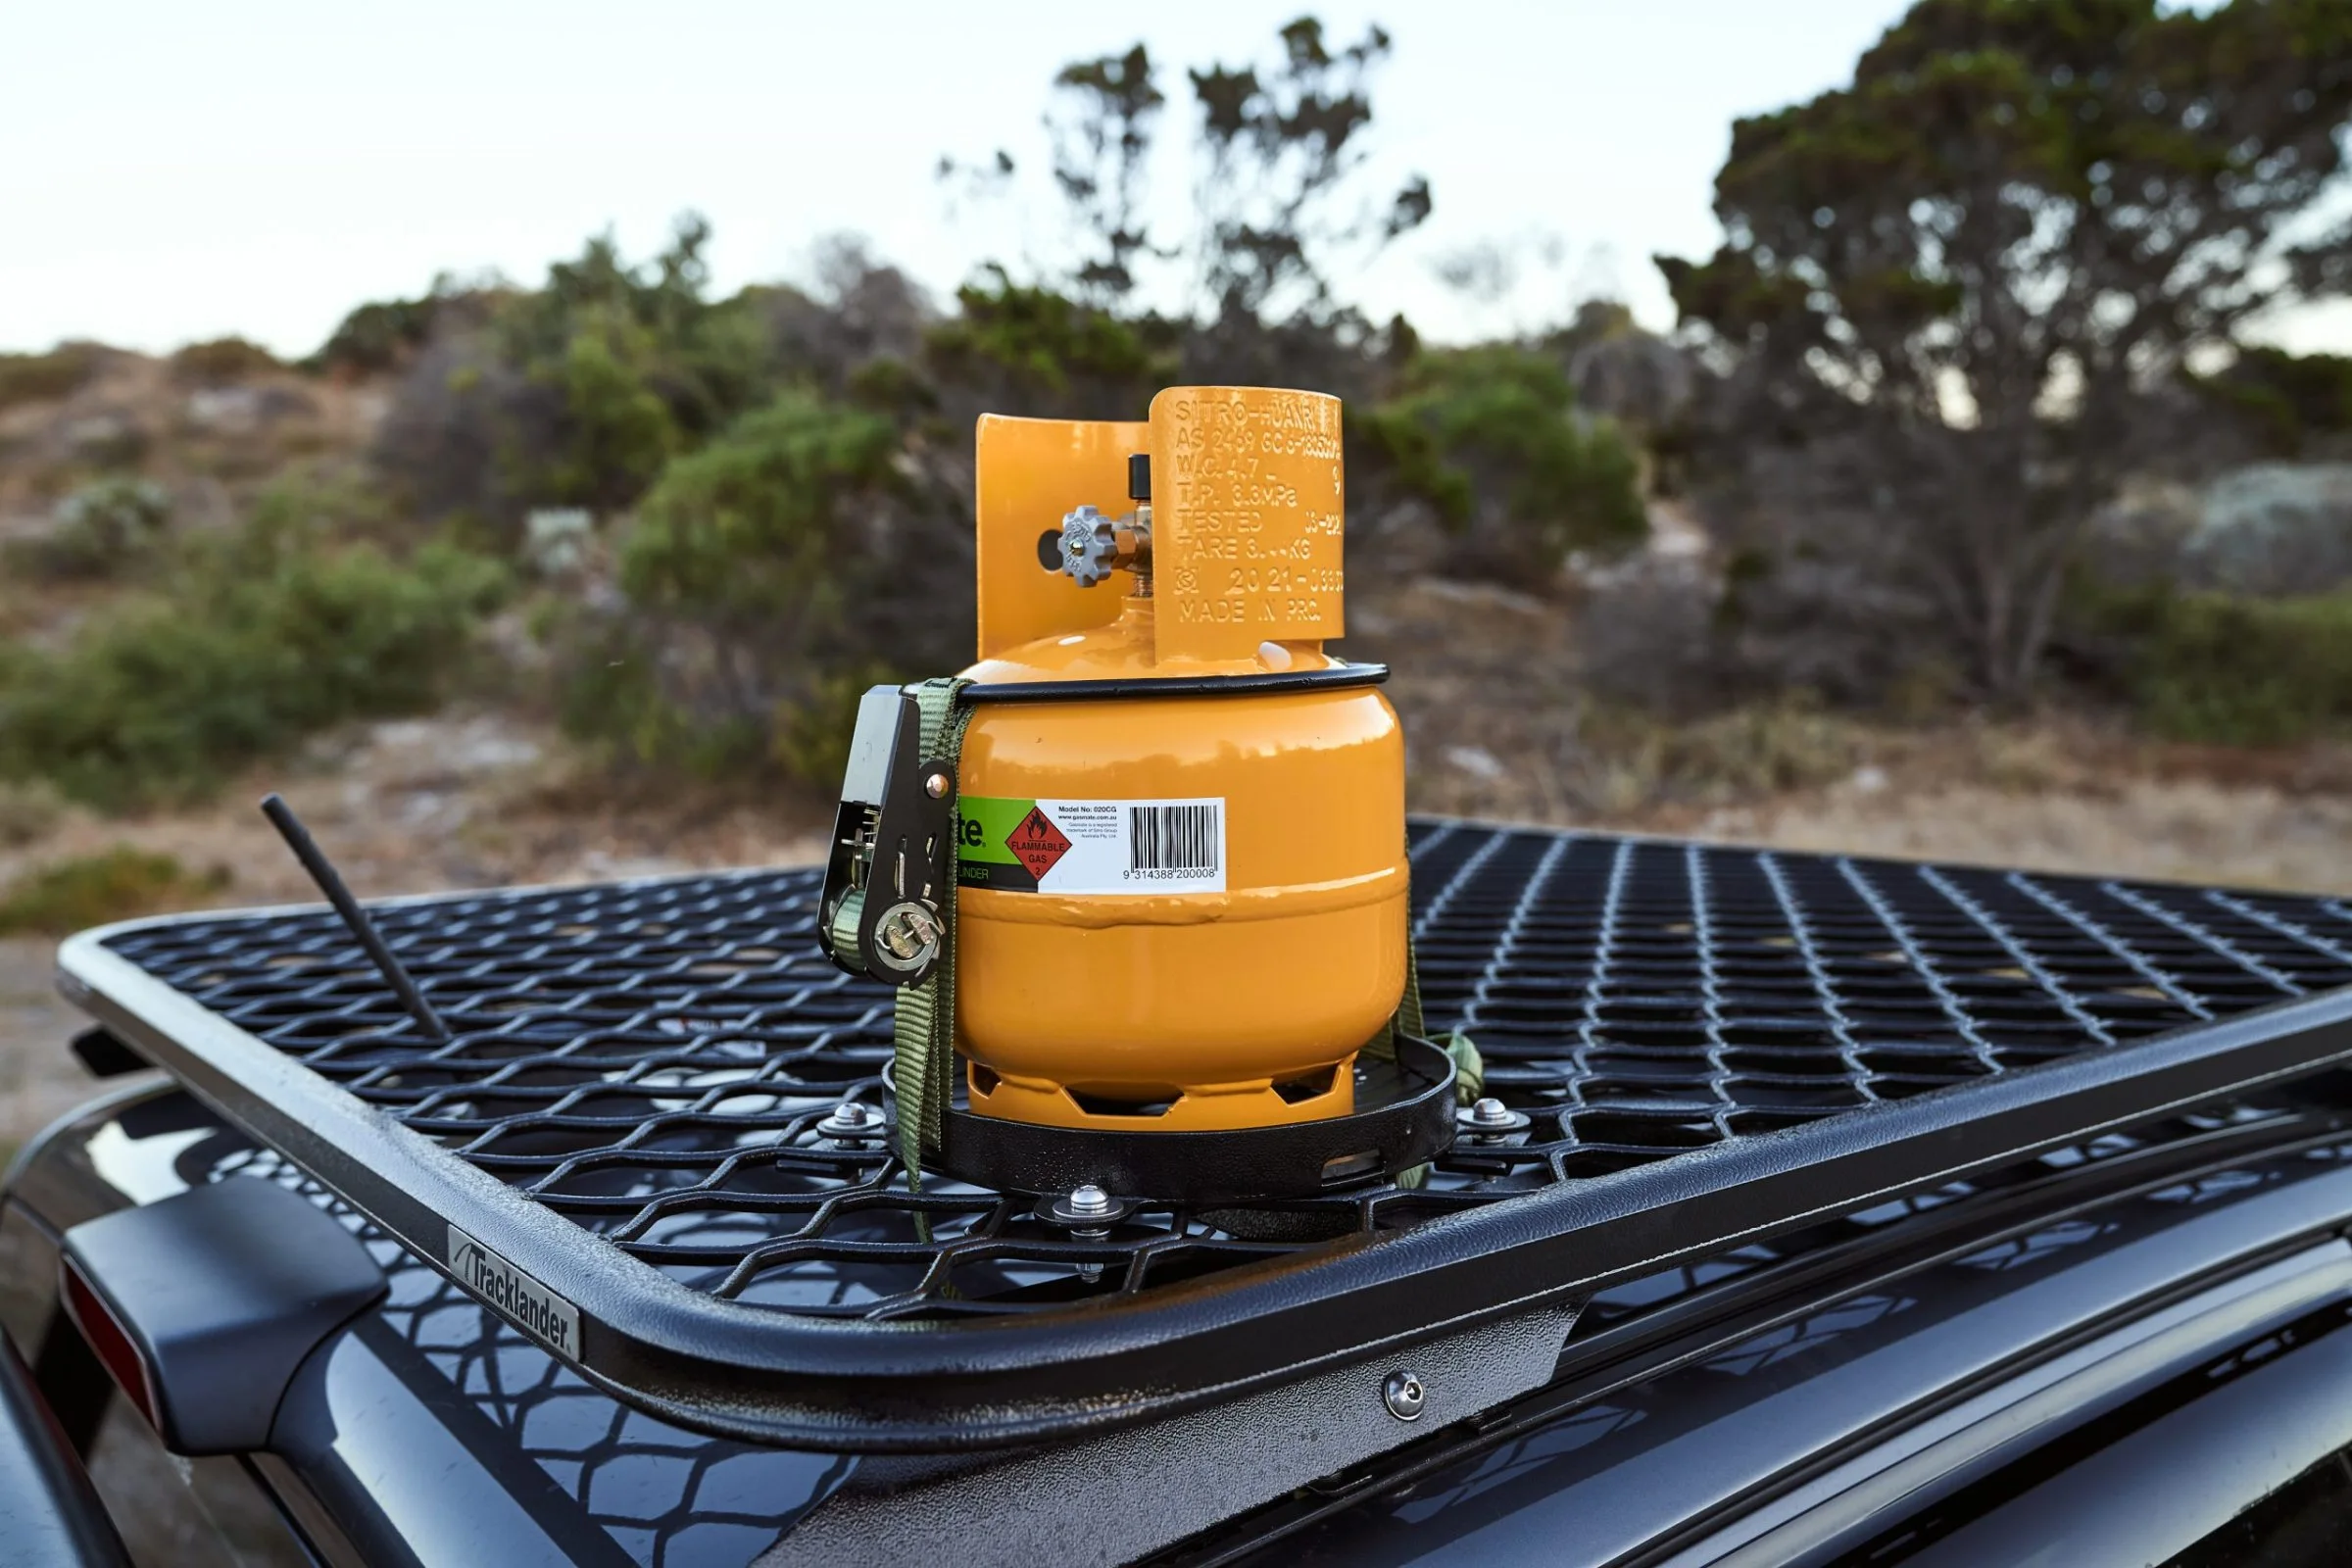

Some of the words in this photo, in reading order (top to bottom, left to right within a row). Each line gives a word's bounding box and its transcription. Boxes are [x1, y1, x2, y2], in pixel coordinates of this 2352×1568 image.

[1176, 428, 1204, 450] AS
[1176, 508, 1262, 533] TESTED
[1177, 535, 1238, 561] TARE
[1179, 598, 1246, 623] MADE
[1258, 598, 1276, 622] IN
[1011, 841, 1065, 853] FLAMMABLE
[1028, 854, 1048, 863] GAS
[1035, 866, 1041, 875] 2
[1123, 869, 1130, 880] 9
[1134, 869, 1174, 880] 314388
[1176, 867, 1215, 879] 200008
[470, 1243, 568, 1349] Tracklander
